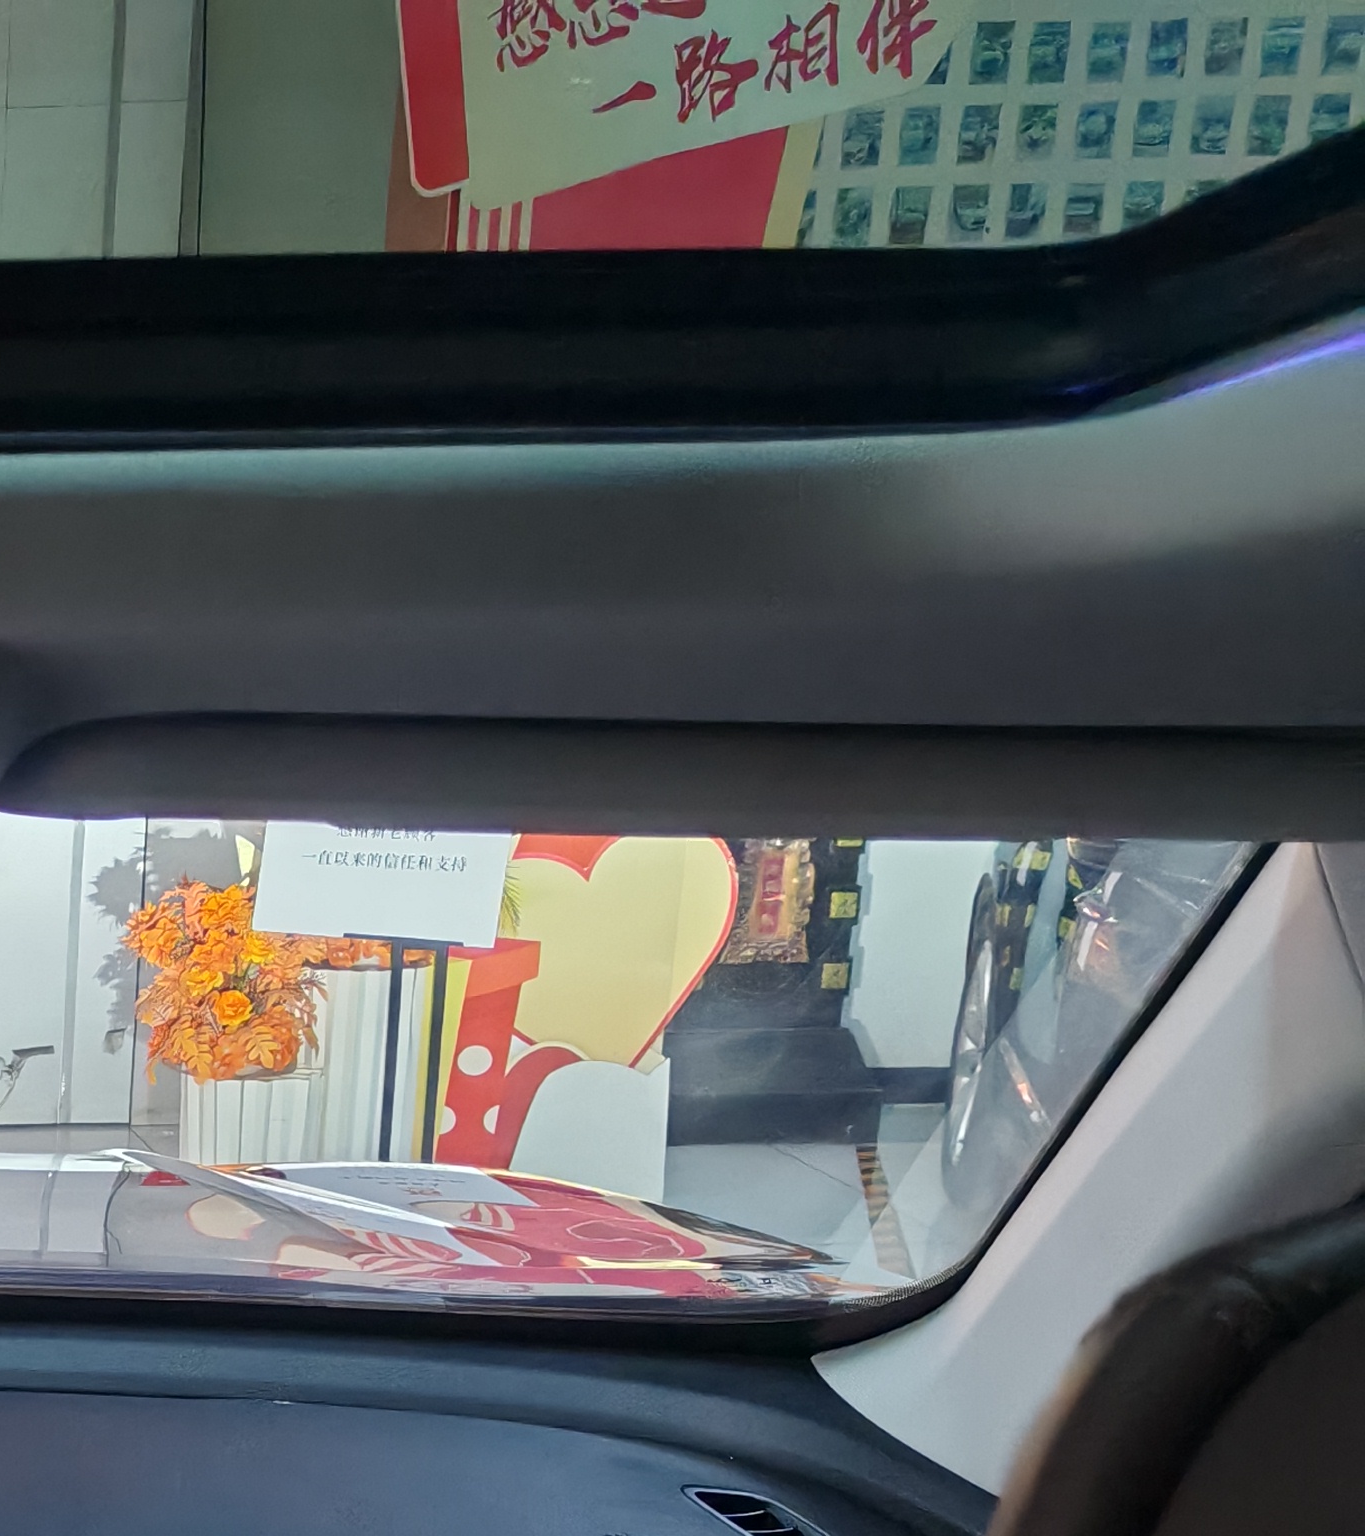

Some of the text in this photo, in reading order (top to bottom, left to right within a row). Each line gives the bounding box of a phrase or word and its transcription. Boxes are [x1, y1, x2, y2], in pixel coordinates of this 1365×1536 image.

[591, 0, 938, 123] 一路相伴
[301, 850, 468, 872] 一直以来的信任和支持
